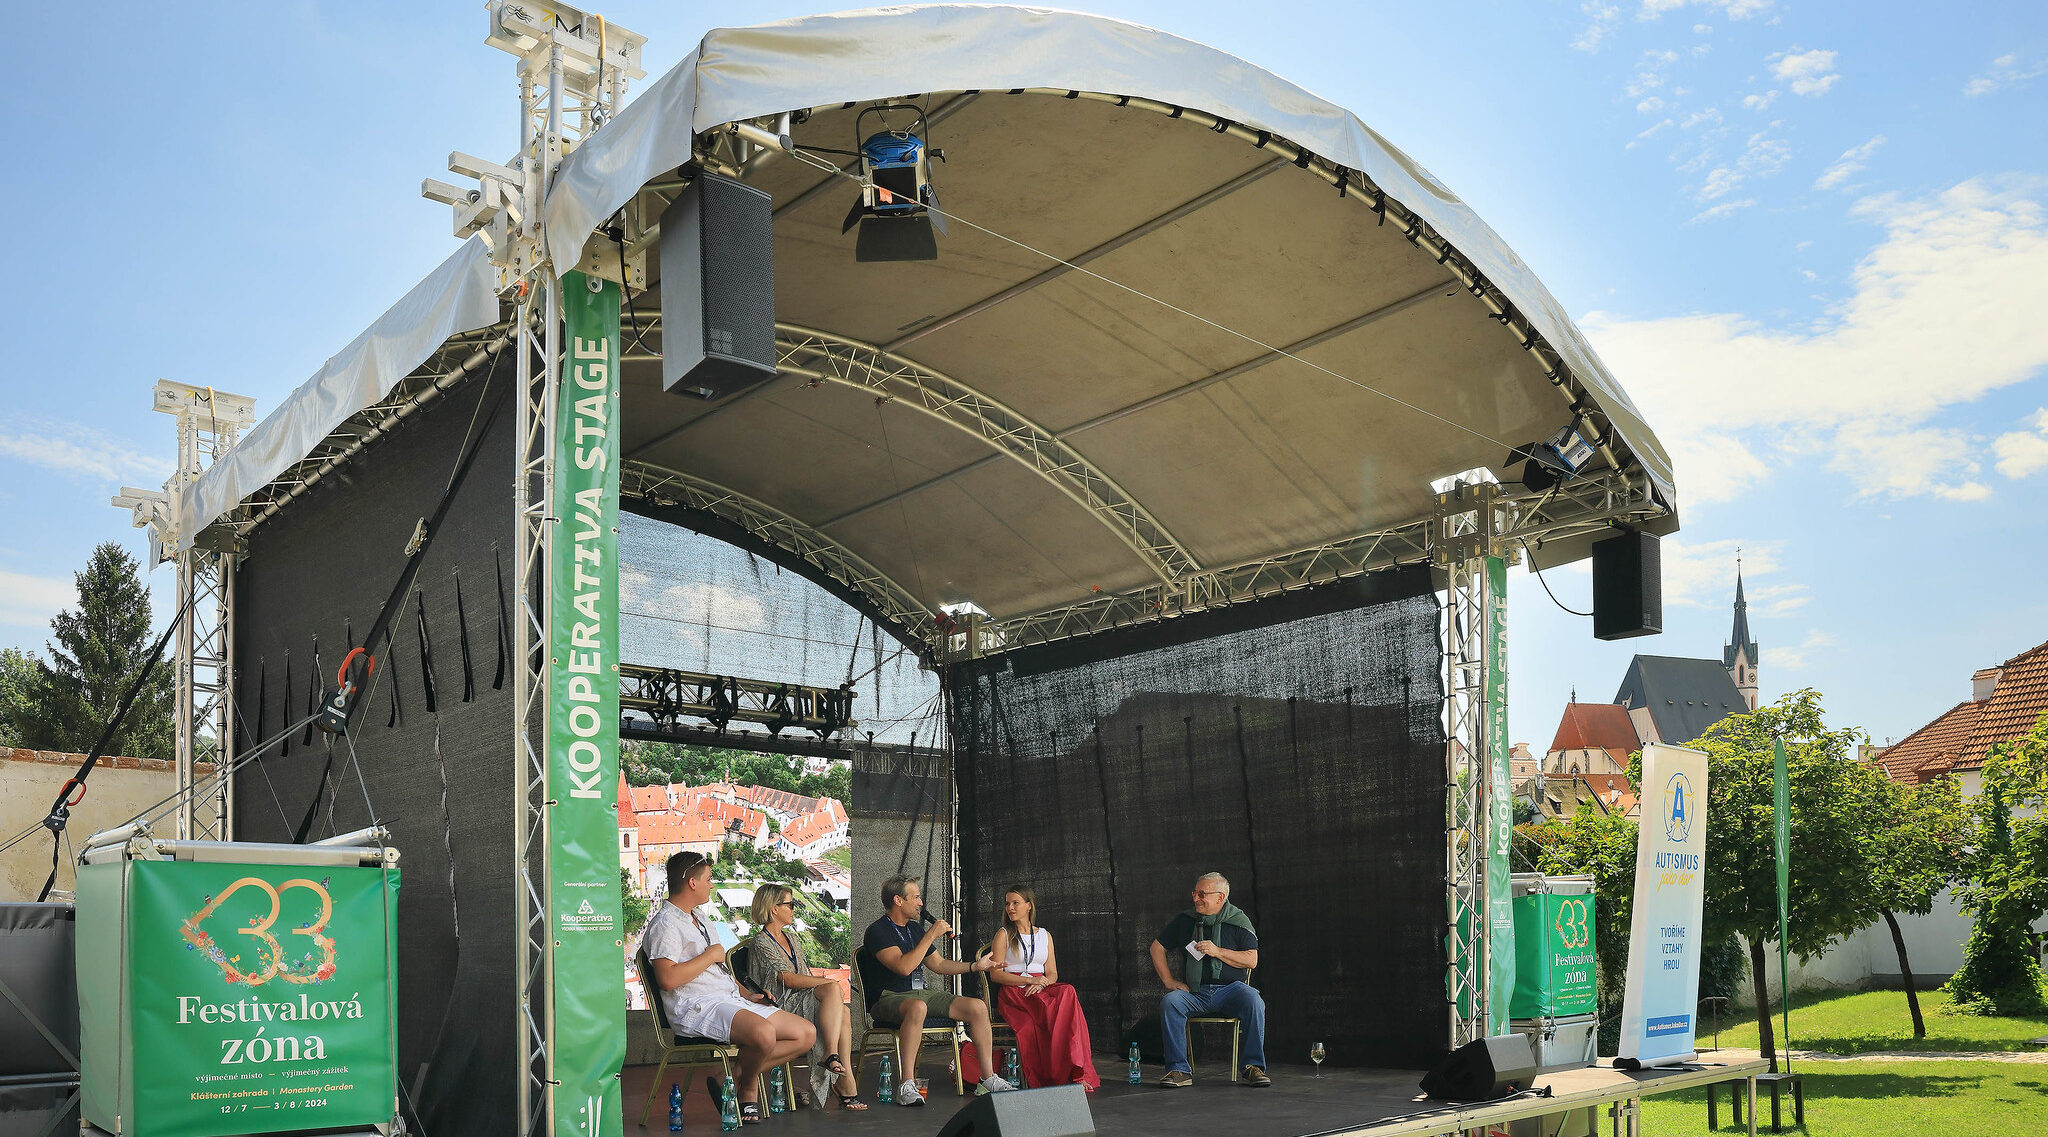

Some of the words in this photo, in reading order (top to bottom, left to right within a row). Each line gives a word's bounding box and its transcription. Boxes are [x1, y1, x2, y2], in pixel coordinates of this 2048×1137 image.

[574, 336, 608, 473] STAGE
[568, 487, 604, 799] KOOPERATIVA
[1655, 851, 1699, 870] AUTISMUS
[1657, 866, 1678, 893] jako
[1678, 867, 1694, 886] dar
[561, 914, 613, 923] Kooperativa
[1660, 924, 1686, 938] TVOŘÍME
[1661, 943, 1684, 954] VZTAHY
[1555, 951, 1595, 966] Festivalová
[1663, 959, 1680, 970] HROU
[1564, 967, 1588, 984] zóna
[176, 992, 364, 1024] Festivalová
[220, 1026, 328, 1065] zóna
[195, 1072, 239, 1083] výjimečné
[241, 1072, 263, 1080] místo
[281, 1067, 321, 1078] výjimečný
[322, 1066, 349, 1075] zážitek
[190, 1091, 231, 1100] Klášterní
[232, 1089, 269, 1098] zahrada
[279, 1086, 323, 1094] Monastery
[324, 1083, 354, 1092] Garden
[220, 1105, 231, 1114] 12
[241, 1104, 248, 1112] 7
[273, 1102, 280, 1110] 3
[289, 1100, 296, 1109] 8
[305, 1098, 328, 1108] 2024
